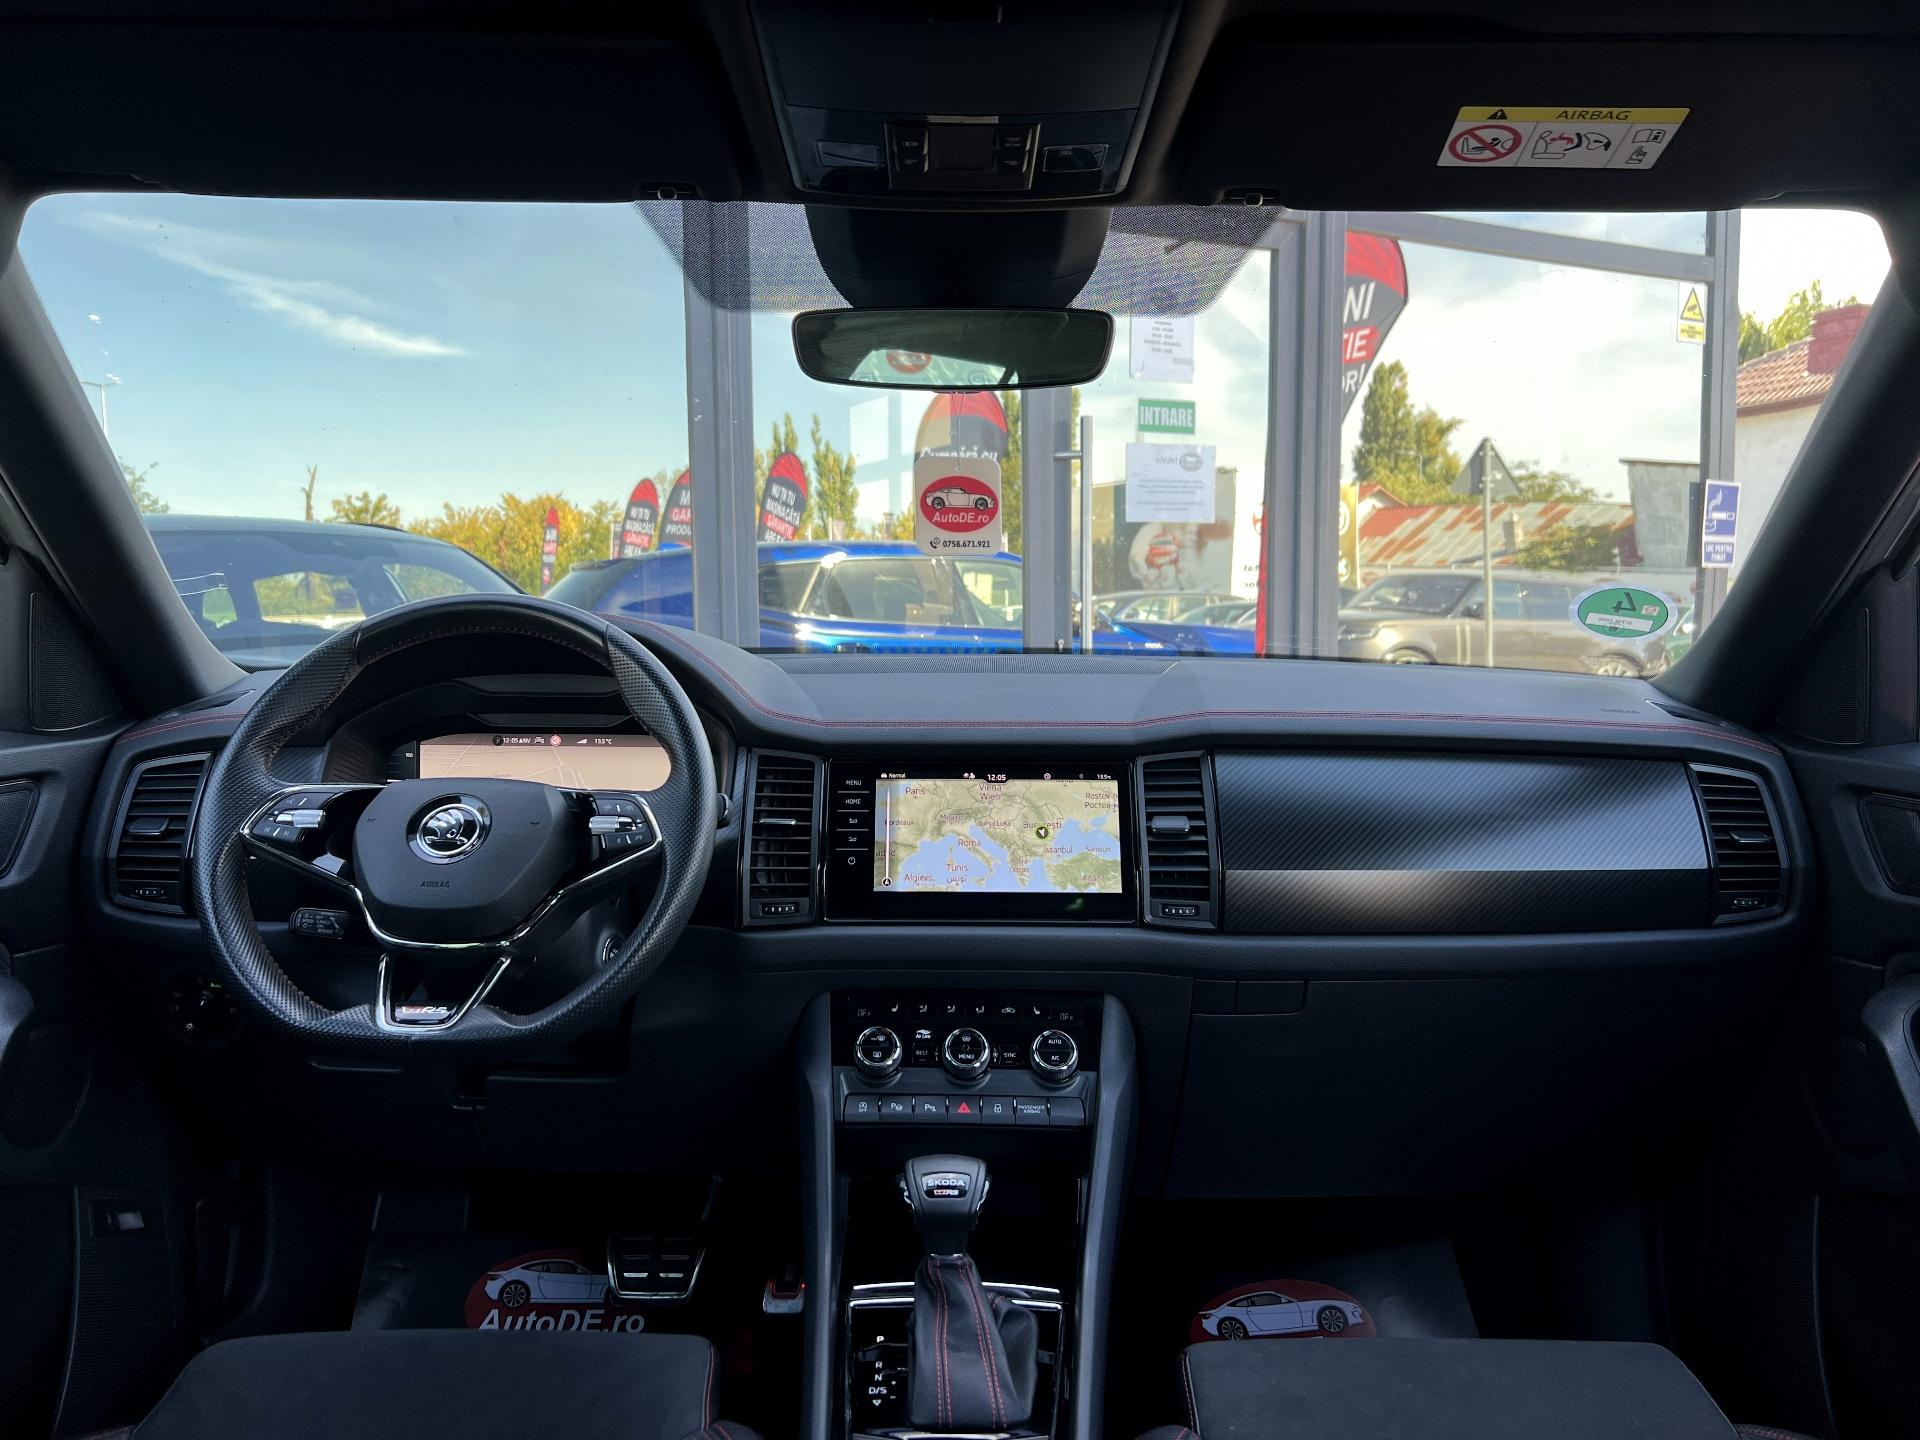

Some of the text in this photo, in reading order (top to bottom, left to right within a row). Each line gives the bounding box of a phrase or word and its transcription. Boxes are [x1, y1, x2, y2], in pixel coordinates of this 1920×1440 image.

[1555, 110, 1631, 121] AIRBAG
[1139, 405, 1194, 427] INTRARE
[932, 511, 990, 523] AutoDE.ro
[942, 540, 991, 548] 0758.671.921
[905, 787, 926, 795] Paris
[979, 784, 1002, 792] Viena
[946, 863, 969, 871] Tunis
[479, 1309, 645, 1335] AutoDE.ro
[875, 1361, 883, 1369] R
[874, 1373, 883, 1381] N
[868, 1386, 888, 1395] D/S
